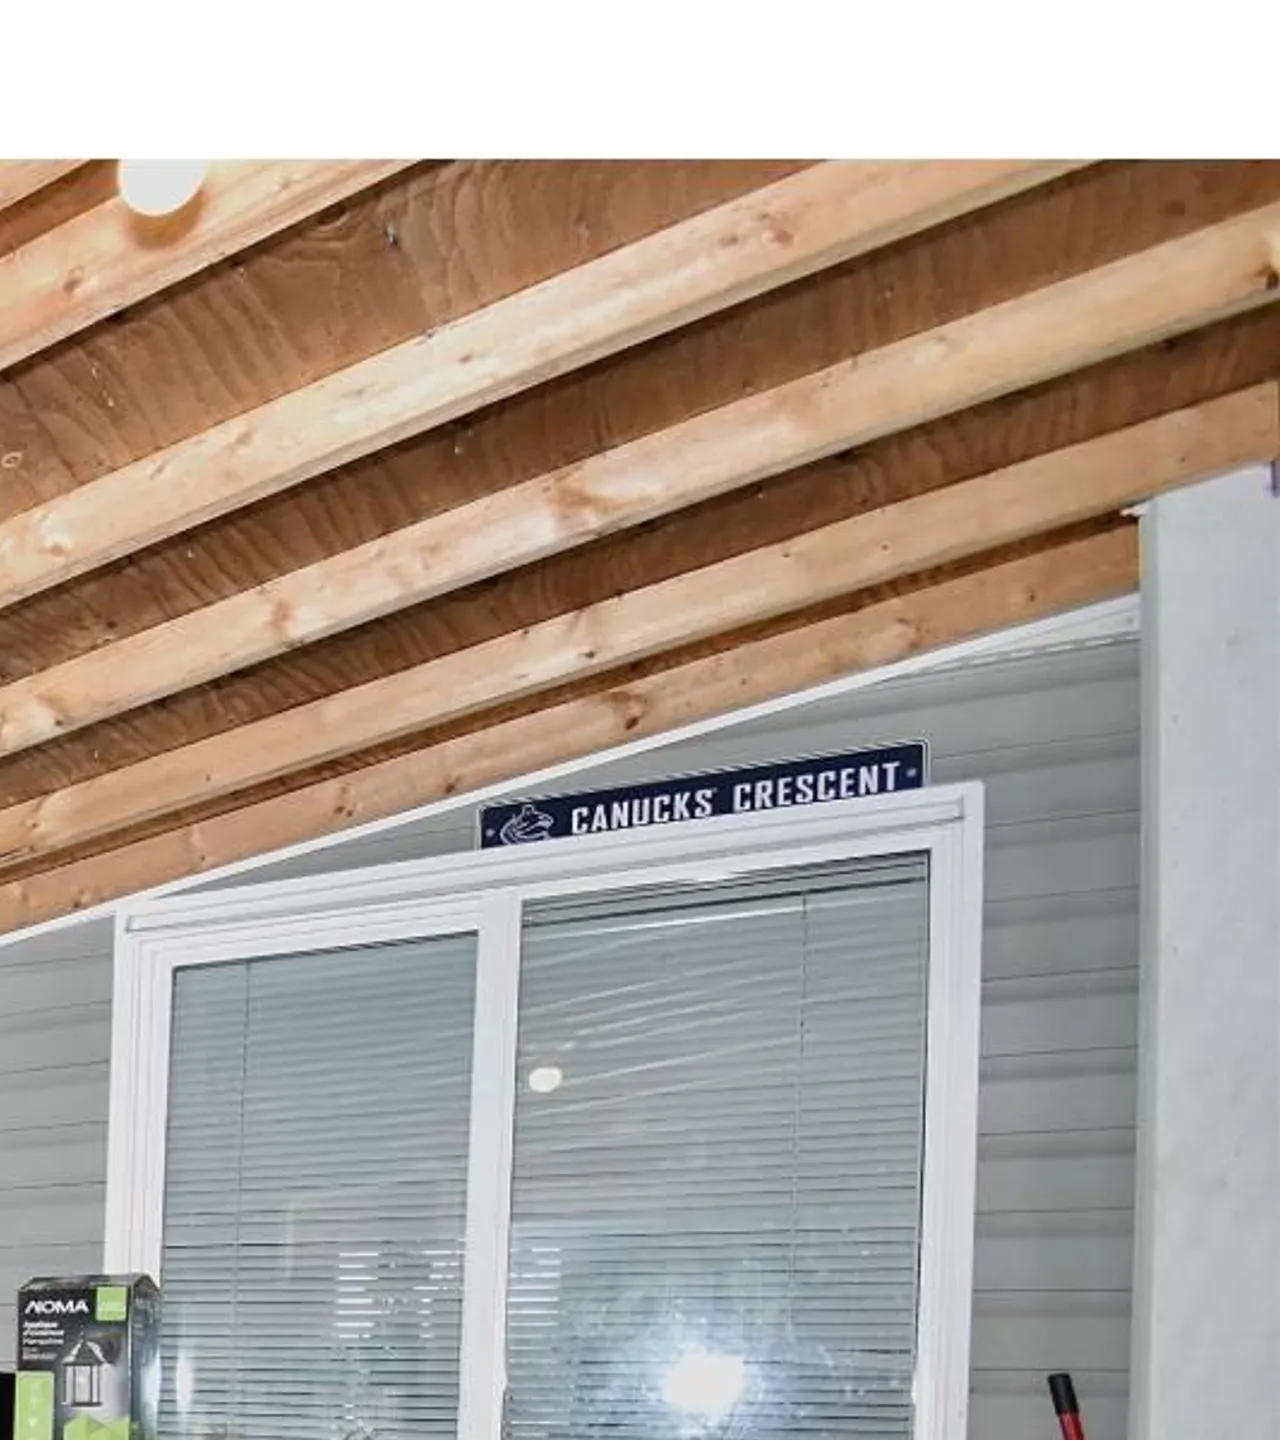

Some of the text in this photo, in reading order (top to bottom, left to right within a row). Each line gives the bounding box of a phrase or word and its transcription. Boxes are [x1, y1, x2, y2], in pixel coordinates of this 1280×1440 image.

[570, 760, 901, 836] CANUCKS CRESCENT
[24, 1300, 90, 1315] NOMA
